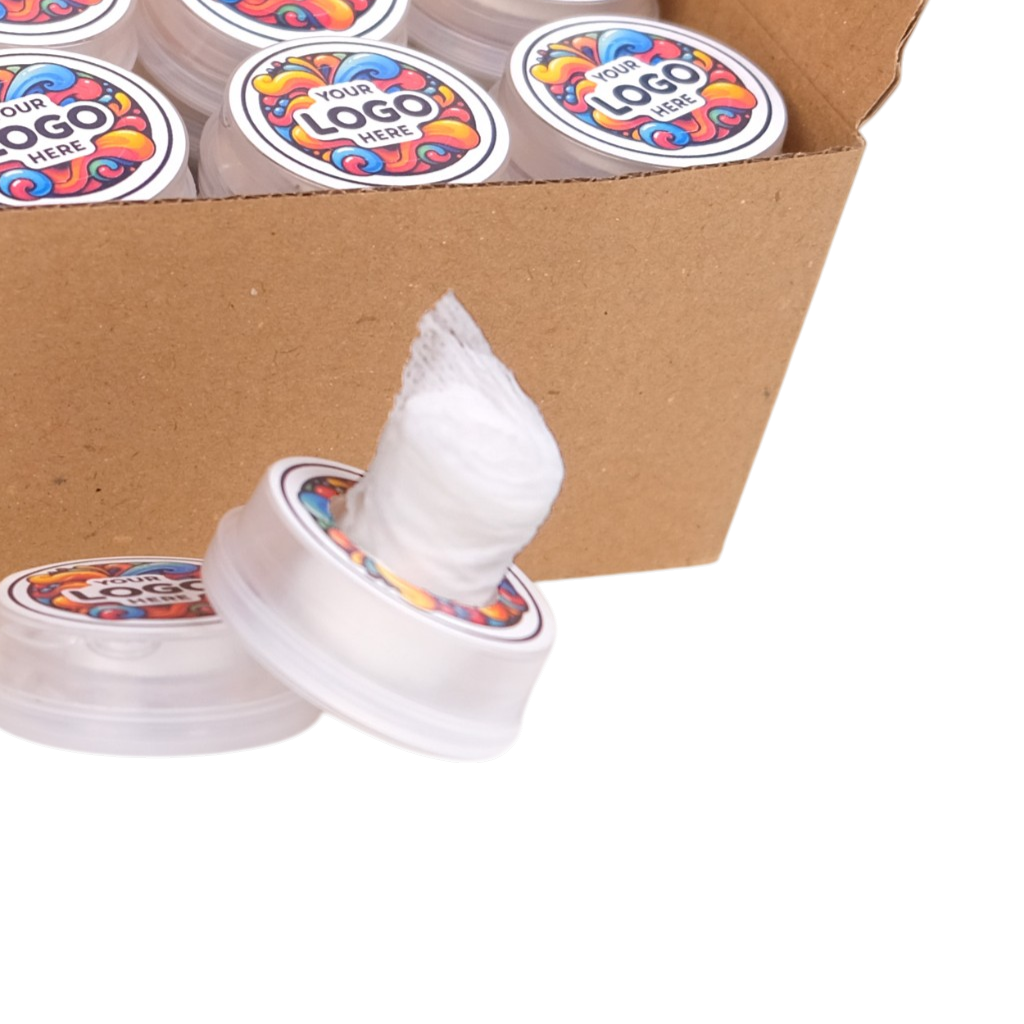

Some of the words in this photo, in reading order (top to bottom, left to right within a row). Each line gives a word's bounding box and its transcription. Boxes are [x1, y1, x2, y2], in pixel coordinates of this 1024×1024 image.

[591, 60, 641, 82] YOUR
[316, 83, 374, 102] YOUR
[590, 63, 700, 116] LOGO
[301, 94, 433, 136] LOGO
[650, 94, 697, 118] HERE
[358, 125, 413, 144] HERE
[27, 141, 87, 165] HERE
[94, 576, 161, 585] YOUR
[127, 596, 192, 605] HERE
